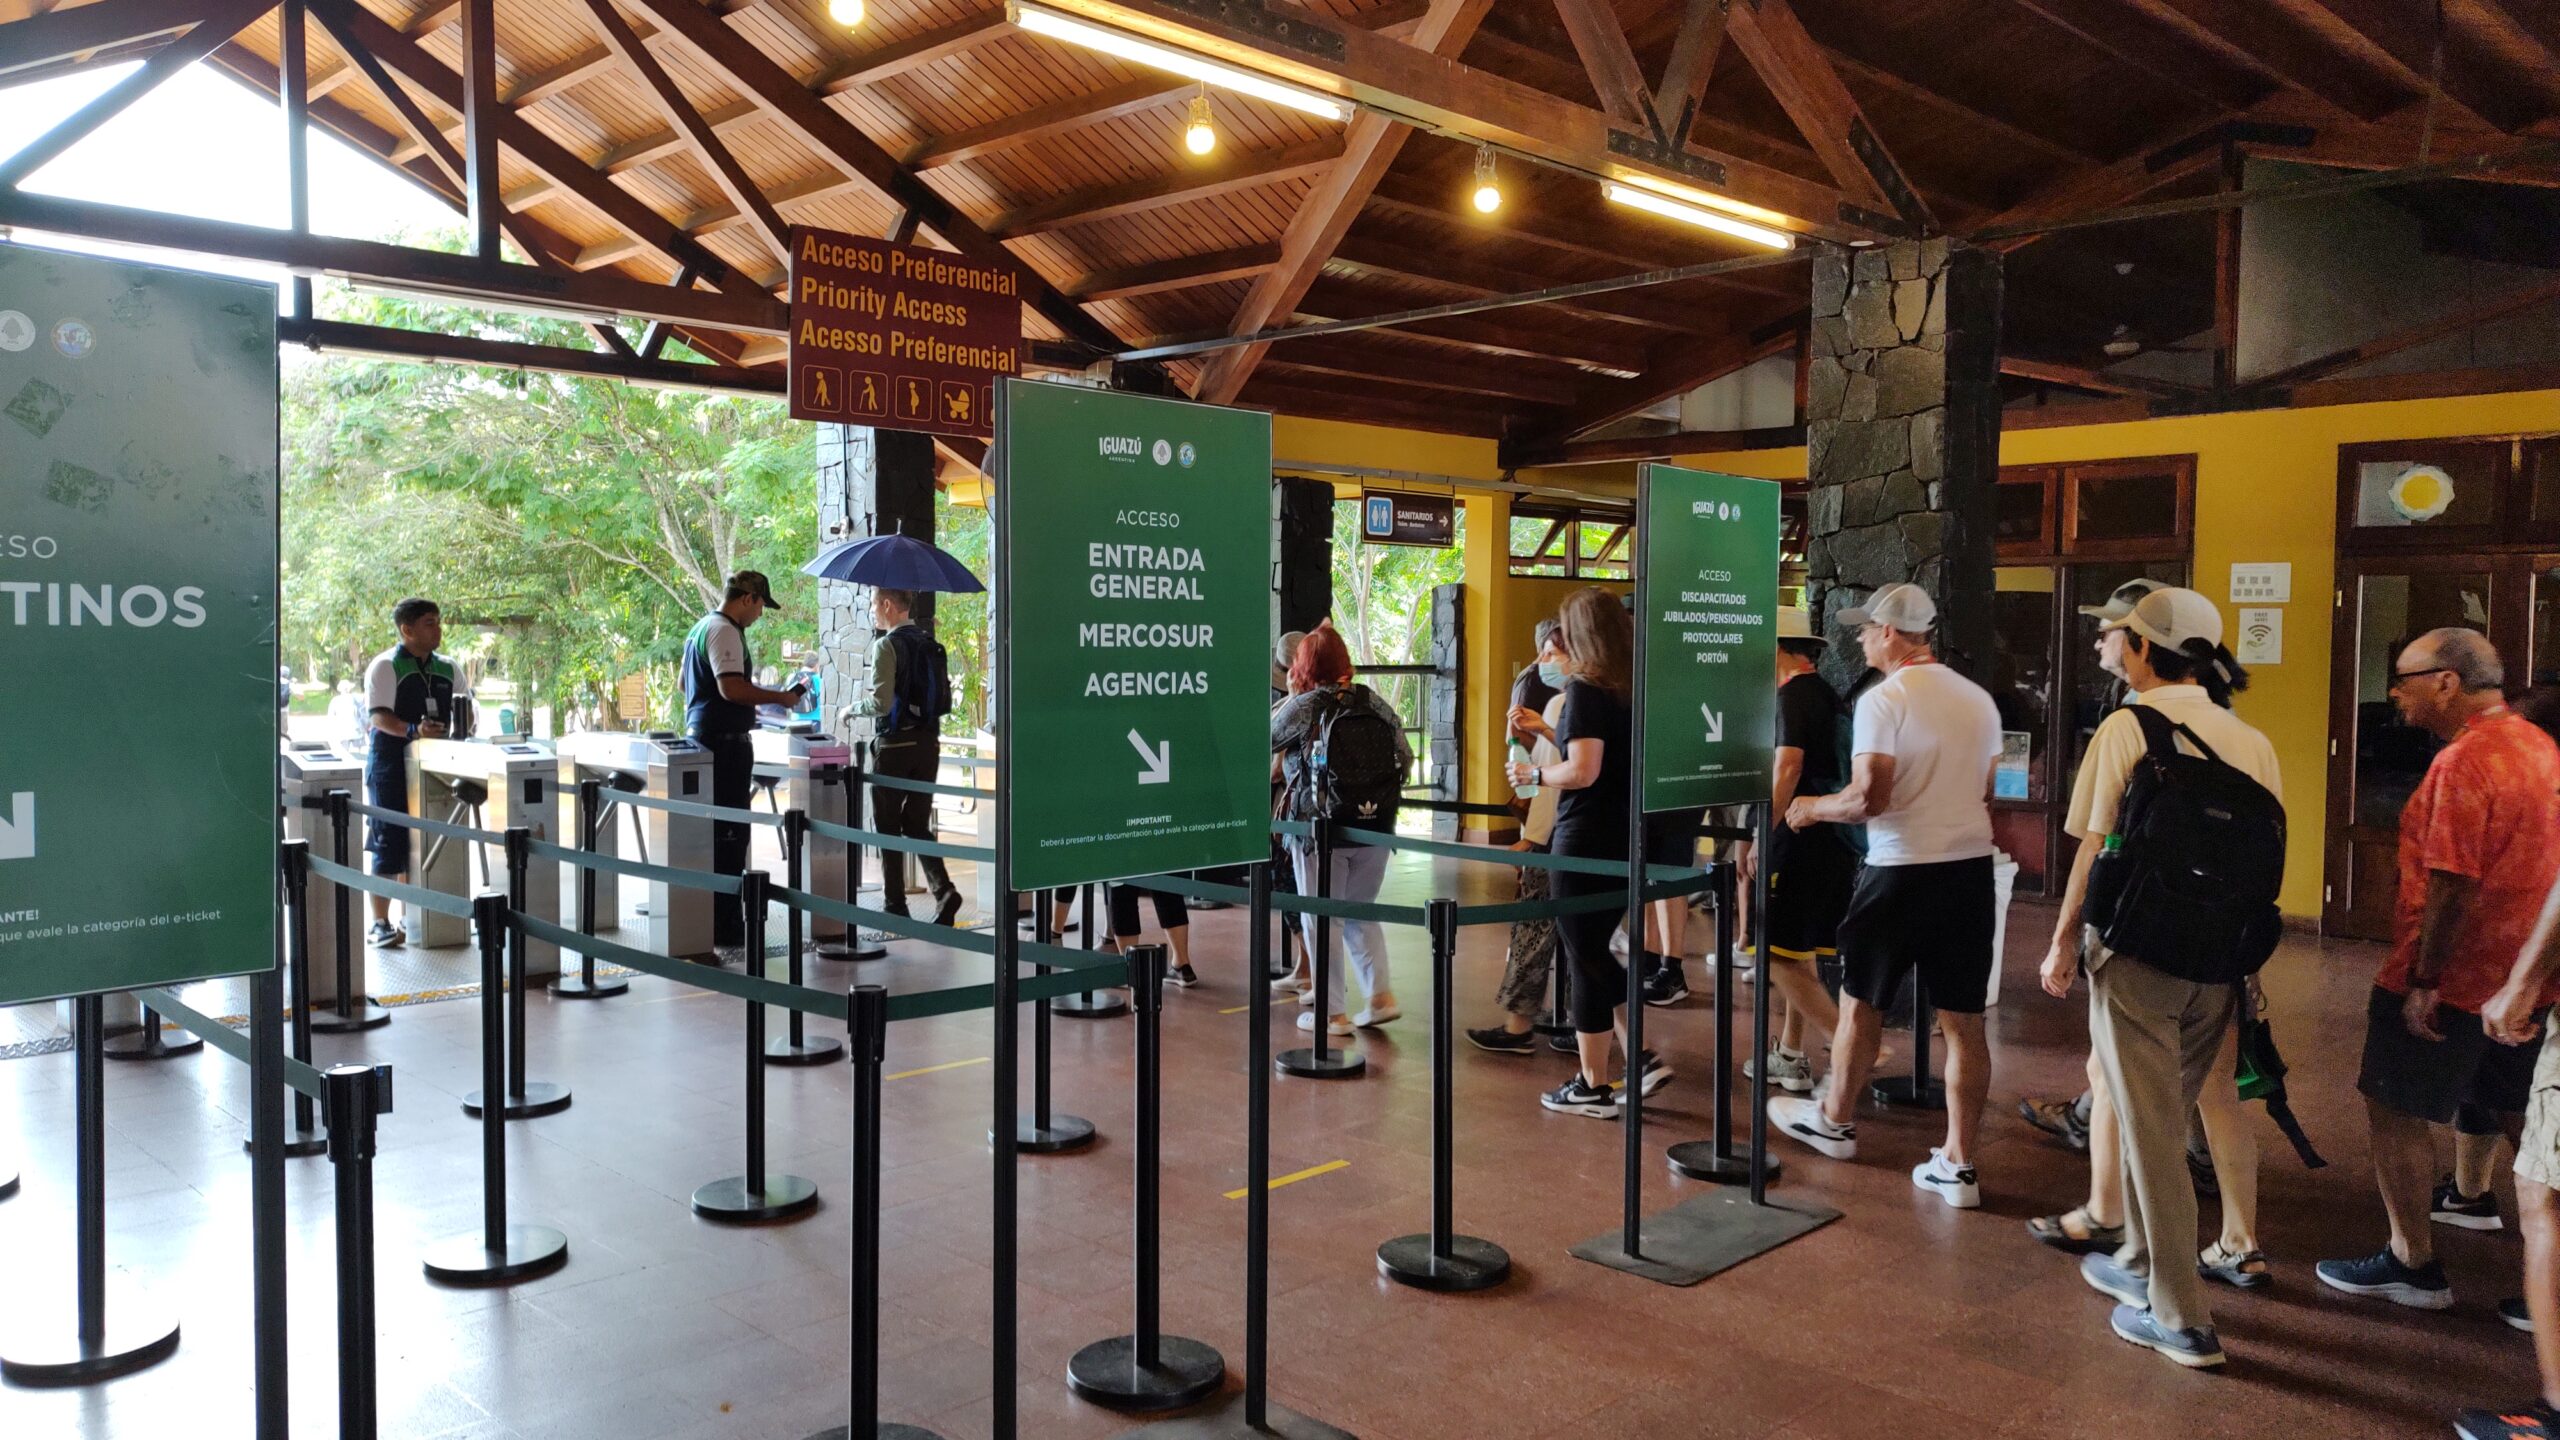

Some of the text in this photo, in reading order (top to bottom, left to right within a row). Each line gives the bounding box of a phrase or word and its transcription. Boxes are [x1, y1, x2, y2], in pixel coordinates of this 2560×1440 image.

[801, 234, 1017, 296] Acceso Preferencial
[801, 276, 967, 327] Priority Access
[799, 319, 1016, 373] Acesso Preferencial
[1099, 436, 1142, 456] IGUAZÚ
[1116, 509, 1180, 528] ACCESO
[1397, 510, 1434, 522] SANITARIOS
[0, 535, 57, 559] SO
[1089, 542, 1206, 572] ENTRADA
[1090, 573, 1205, 601] GENERAL
[1698, 569, 1731, 582] ACCESO
[0, 581, 207, 628] TINOS
[1681, 591, 1747, 605] DISCAPACITADOS
[1663, 611, 1763, 625] JUBILADOS/PENSIONADOS
[1079, 623, 1214, 648] MERCOSUR
[1682, 632, 1743, 644] PROTOCOLARES
[1696, 650, 1729, 663] PORTÓN
[1084, 671, 1209, 696] AGENCIAS
[1040, 838, 1064, 847] Deberá
[1066, 835, 1096, 846] presentar
[1097, 833, 1104, 841] la
[1104, 828, 1152, 841] documentación
[1182, 824, 1188, 832] la
[1216, 821, 1225, 829] del
[27, 925, 63, 940] avale
[67, 923, 79, 935] la
[83, 917, 146, 932] categoría
[150, 914, 170, 926] del
[173, 909, 221, 924] e-ticket
